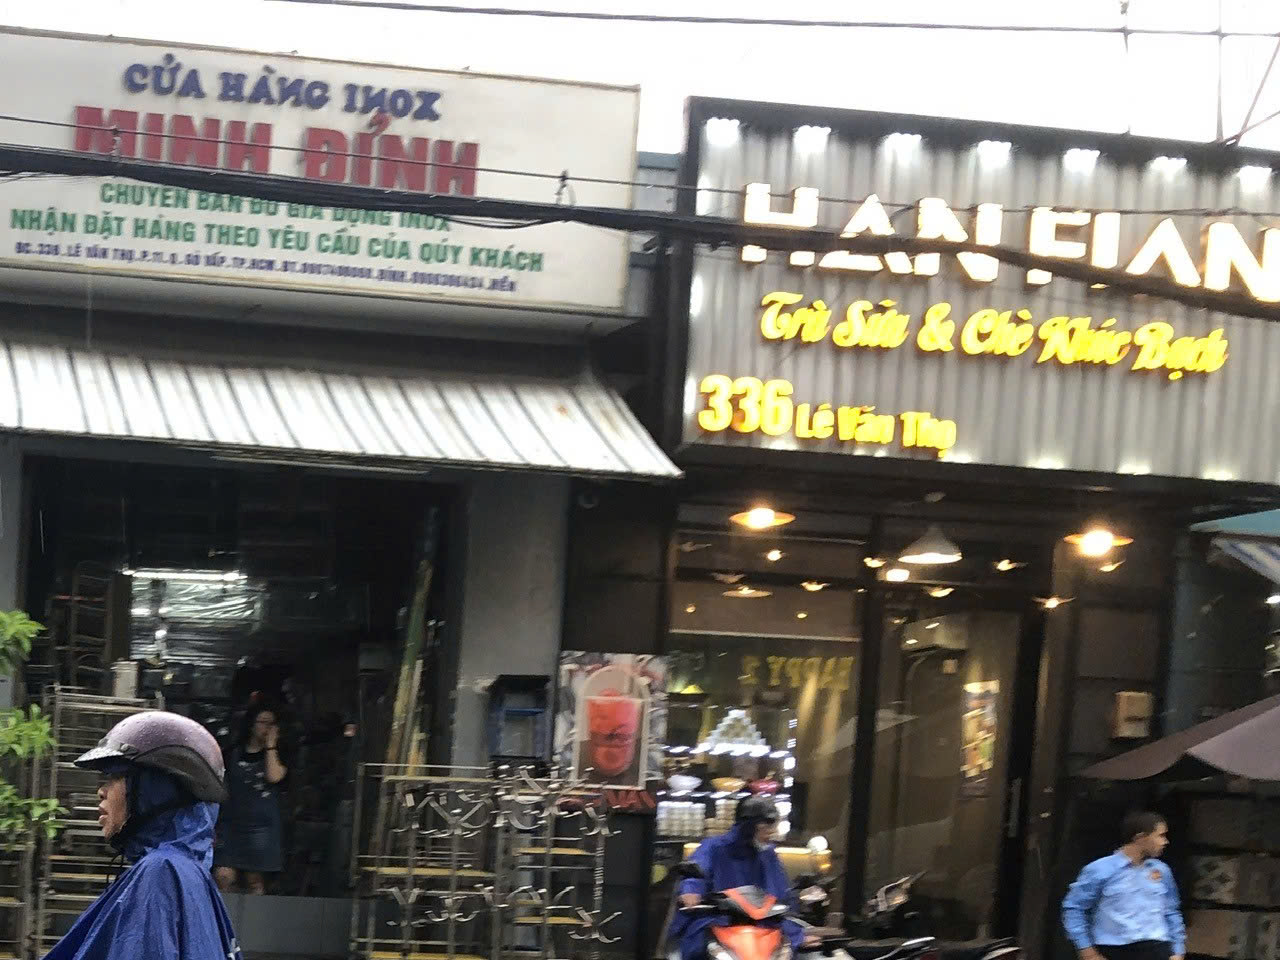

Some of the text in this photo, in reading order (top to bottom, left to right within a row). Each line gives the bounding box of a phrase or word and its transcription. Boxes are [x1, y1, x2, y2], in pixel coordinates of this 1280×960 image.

[124, 53, 443, 122] CỬA HÀNG INOX
[74, 105, 272, 174] MINH
[11, 206, 77, 236] NHẬN
[83, 210, 126, 240] ĐẶT
[132, 213, 197, 243] HÀNG
[204, 223, 260, 247] THEO
[267, 224, 310, 252] YÊU
[368, 231, 412, 261] CỦA
[418, 238, 465, 265] QUÝ
[470, 244, 545, 273] KHÁCH
[760, 291, 832, 344] Trà
[916, 302, 956, 353] &
[697, 374, 794, 437] 336
